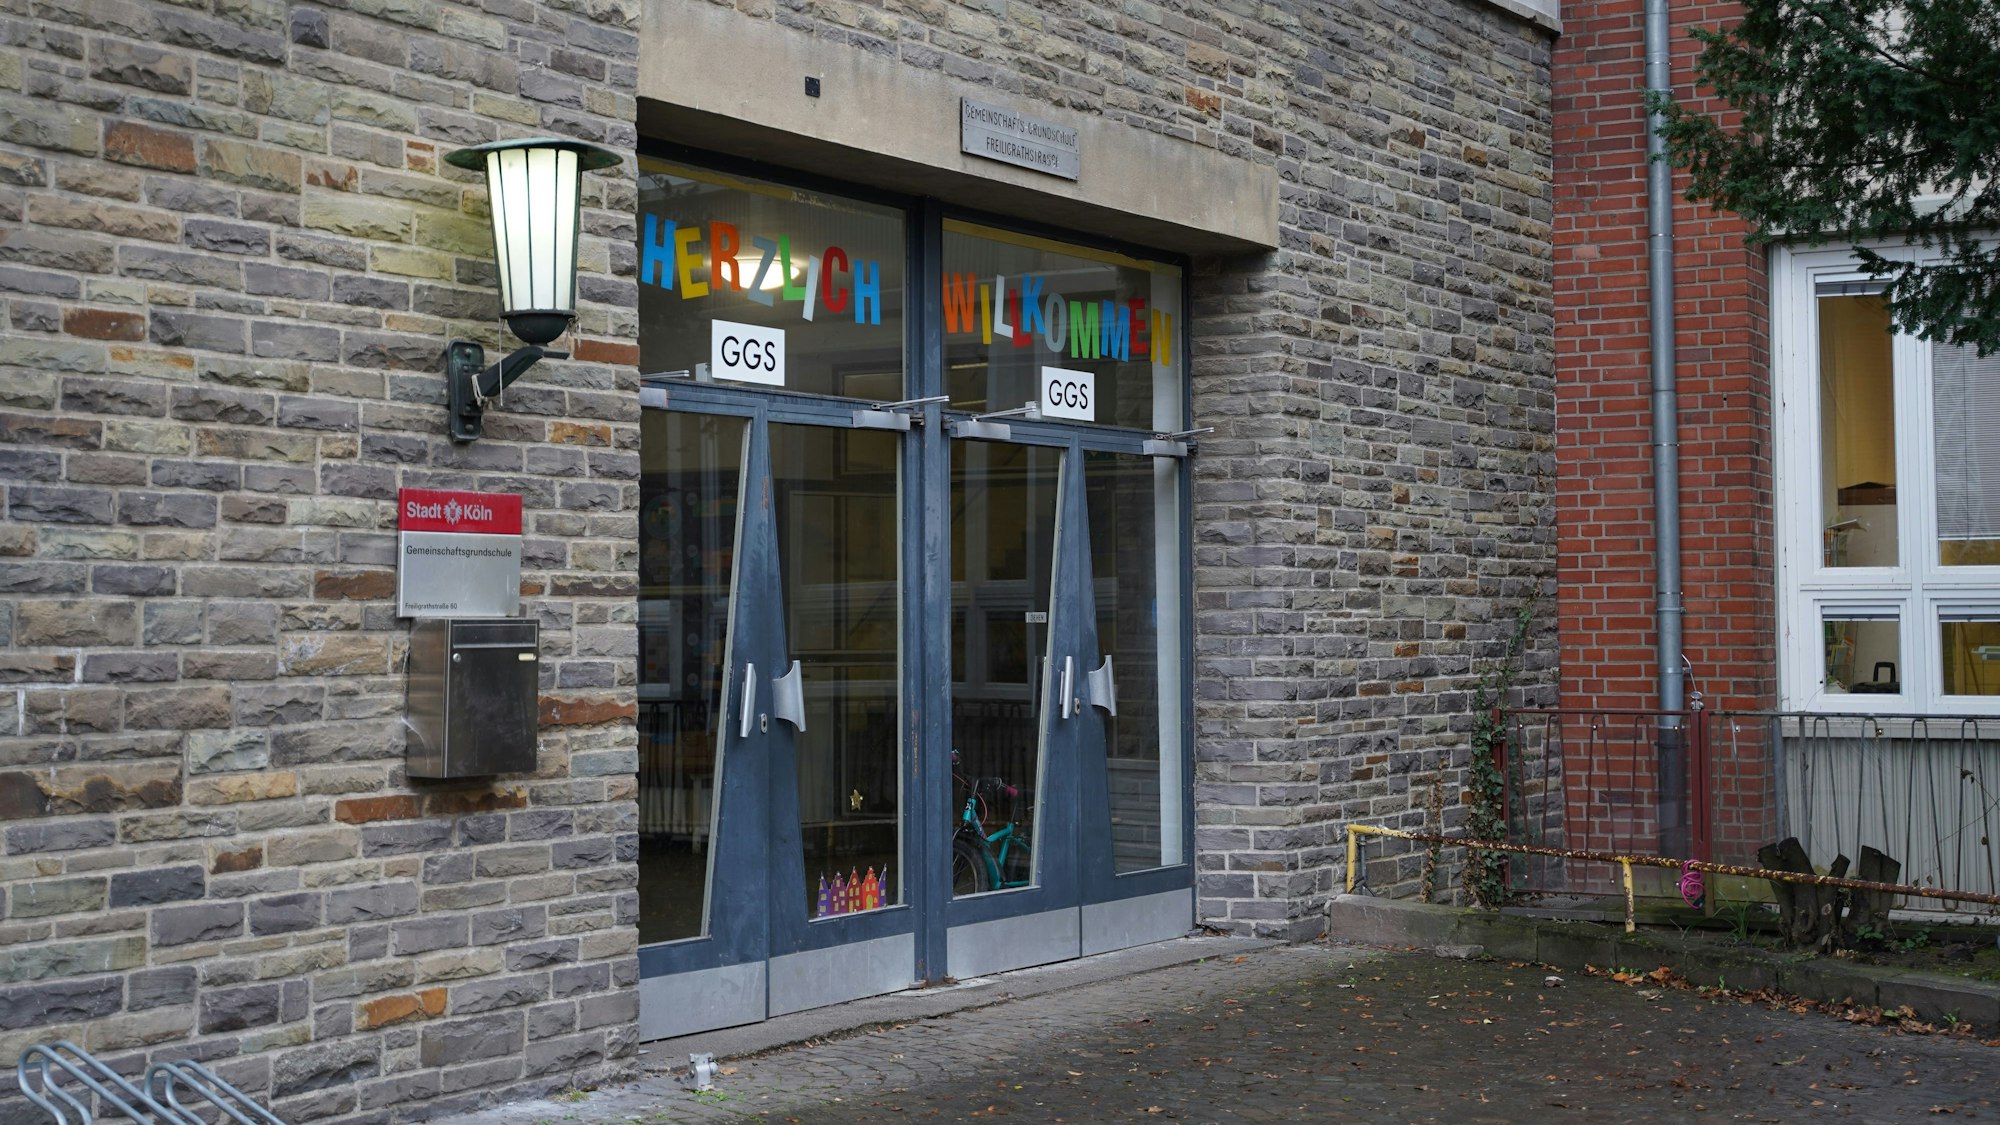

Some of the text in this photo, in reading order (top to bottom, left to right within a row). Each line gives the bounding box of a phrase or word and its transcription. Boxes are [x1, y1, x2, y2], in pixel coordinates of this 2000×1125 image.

[641, 212, 881, 326] HERZLICH
[942, 271, 1172, 368] WILLKOMMEN
[721, 335, 776, 372] GGS
[1049, 379, 1089, 410] GGS
[406, 501, 493, 521] Stadt Köln
[406, 545, 512, 558] Gemeinschaftsgrundschule
[405, 602, 449, 610] Freiligrathstraße
